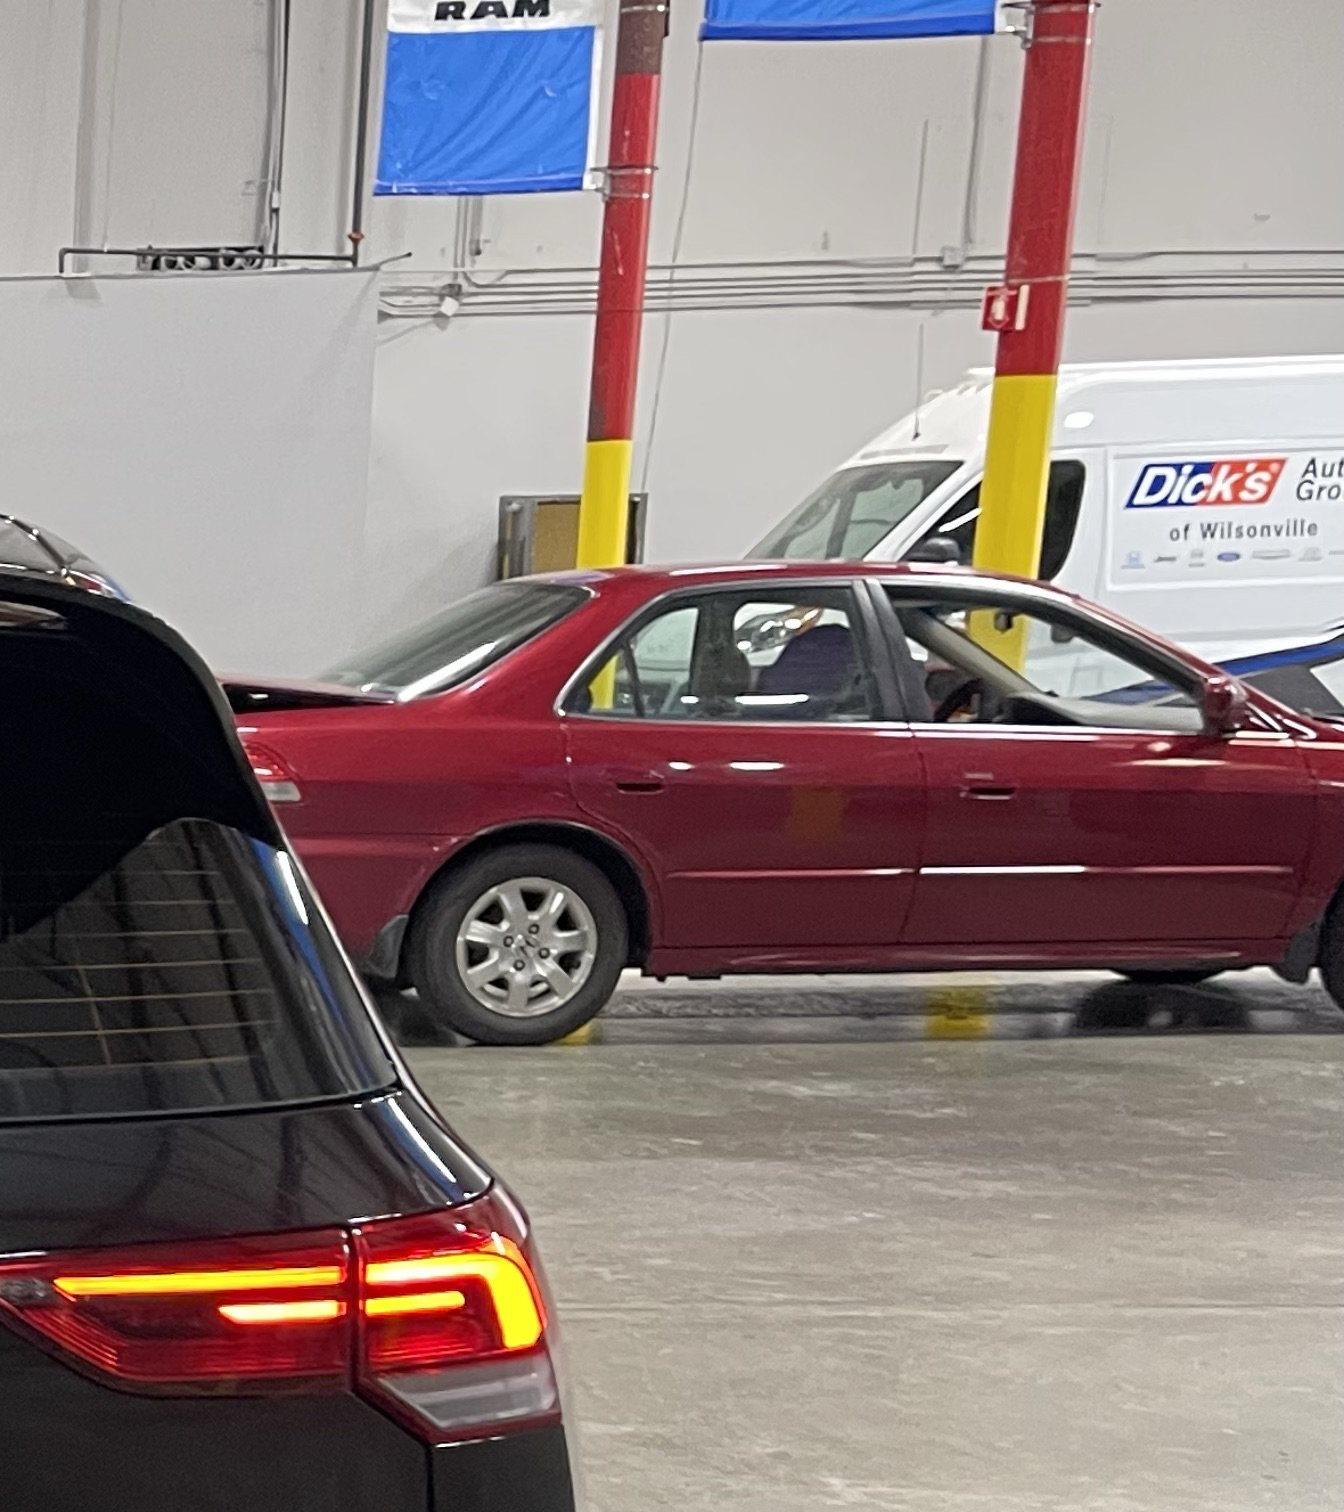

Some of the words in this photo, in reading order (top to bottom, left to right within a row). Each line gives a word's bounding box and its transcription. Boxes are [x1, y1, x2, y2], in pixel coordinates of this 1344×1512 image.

[434, 0, 551, 21] RAM
[1301, 456, 1344, 479] Aut
[1296, 479, 1344, 501] Gro
[1169, 524, 1191, 542] of
[1199, 518, 1319, 541] Wilsonville
